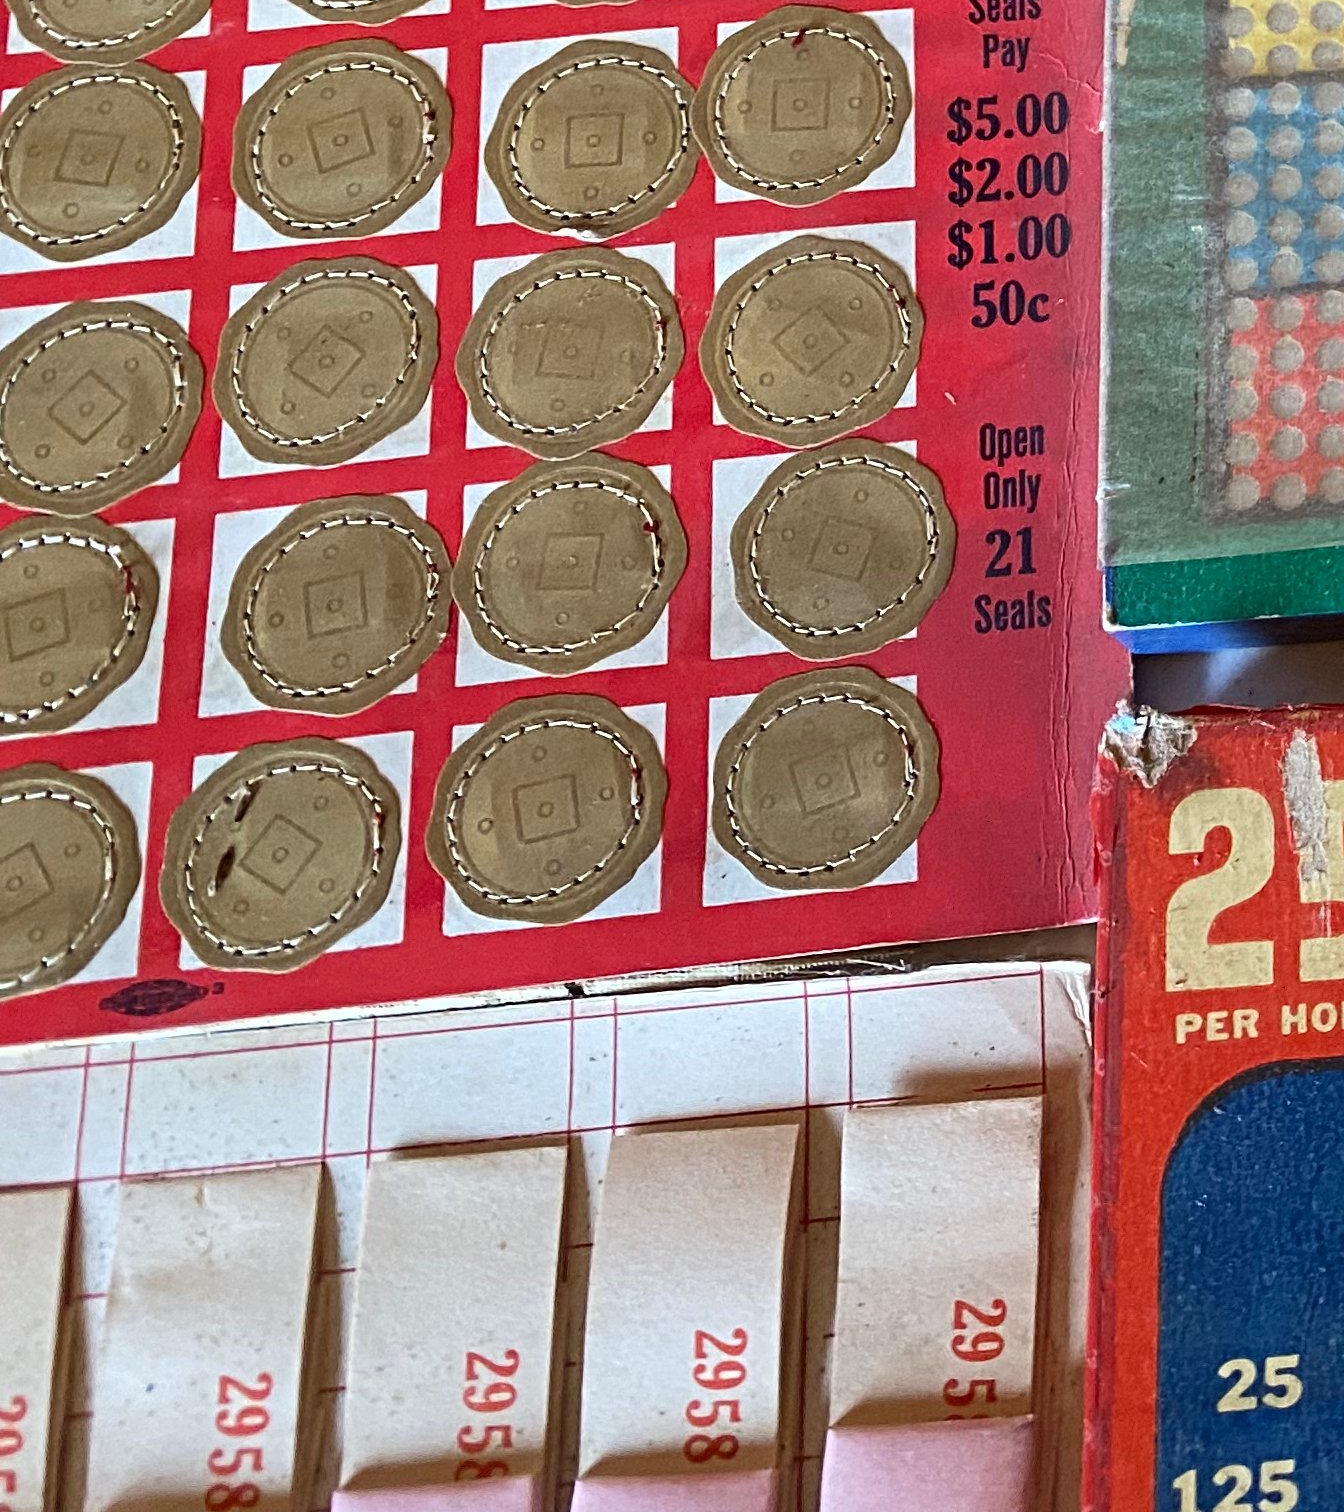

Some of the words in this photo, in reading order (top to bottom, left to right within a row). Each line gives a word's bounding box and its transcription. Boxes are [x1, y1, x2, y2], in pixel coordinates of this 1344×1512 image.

[982, 33, 1031, 72] Pay
[946, 90, 1069, 145] $5.00
[946, 152, 1070, 204] $2.00
[946, 212, 1071, 268] $1.00
[970, 280, 1051, 328] 50c
[979, 423, 1045, 468] Open
[982, 469, 1042, 513] Only
[984, 528, 1038, 579] 21
[975, 594, 1052, 633] Seals
[1175, 1009, 1258, 1045] PER
[943, 1298, 1007, 1421] 295
[1217, 1355, 1303, 1412] 25
[683, 1326, 749, 1464] 2958
[1172, 1460, 1300, 1512] 125
